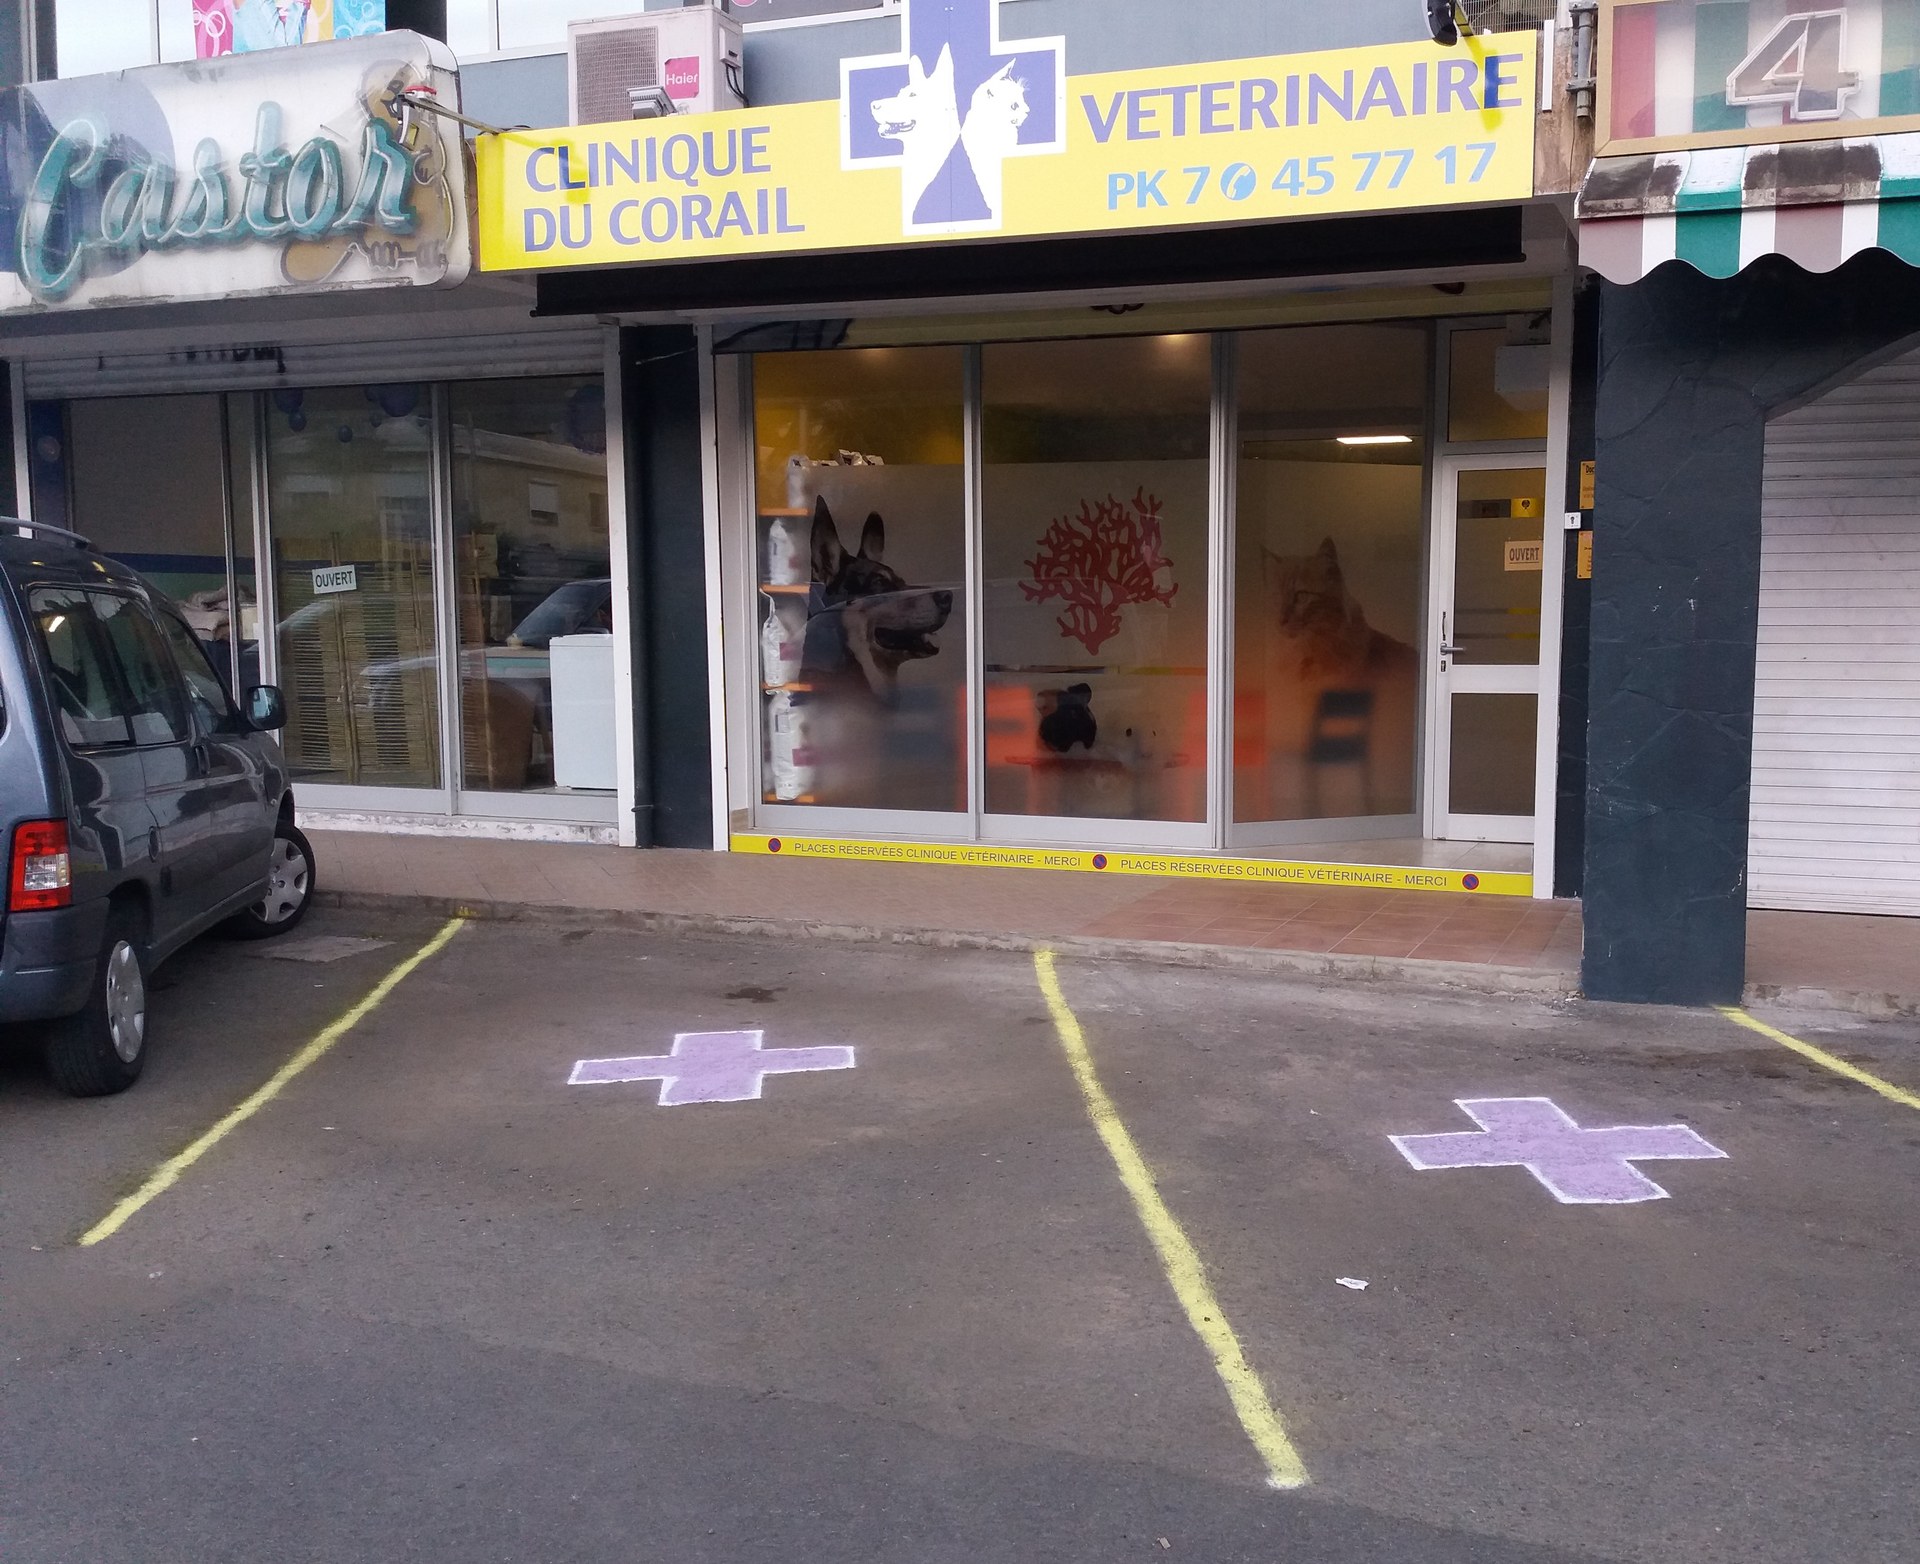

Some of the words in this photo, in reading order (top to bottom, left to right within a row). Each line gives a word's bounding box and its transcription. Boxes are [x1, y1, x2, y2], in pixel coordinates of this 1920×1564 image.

[666, 72, 698, 85] Haier
[1724, 8, 1861, 121] 4
[1081, 53, 1523, 144] VETERINAIRE
[525, 126, 771, 193] CLINIQUE
[1108, 169, 1166, 210] PK
[1183, 166, 1210, 205] 7
[1272, 155, 1334, 197] 45
[1352, 148, 1414, 192] 77
[1434, 143, 1497, 186] 17
[18, 100, 417, 303] Castor
[524, 203, 592, 252] DU
[609, 187, 805, 245] CORAIL
[315, 571, 352, 588] OUVERT
[1509, 547, 1539, 562] OUVERT
[794, 843, 836, 854] PLACES
[839, 844, 903, 857] RÉSERVÉES
[906, 848, 958, 860] CLINIQUE
[960, 848, 1034, 864] VÉTÉRINAIRE
[1044, 856, 1081, 867] MERCI
[1121, 859, 1166, 871] PLACES
[1170, 860, 1244, 875] RÉSERVÉES
[1246, 866, 1304, 879] CLINIQUE
[1308, 867, 1393, 883] VÉTÉRINAIRE
[1405, 875, 1447, 887] MERCI
